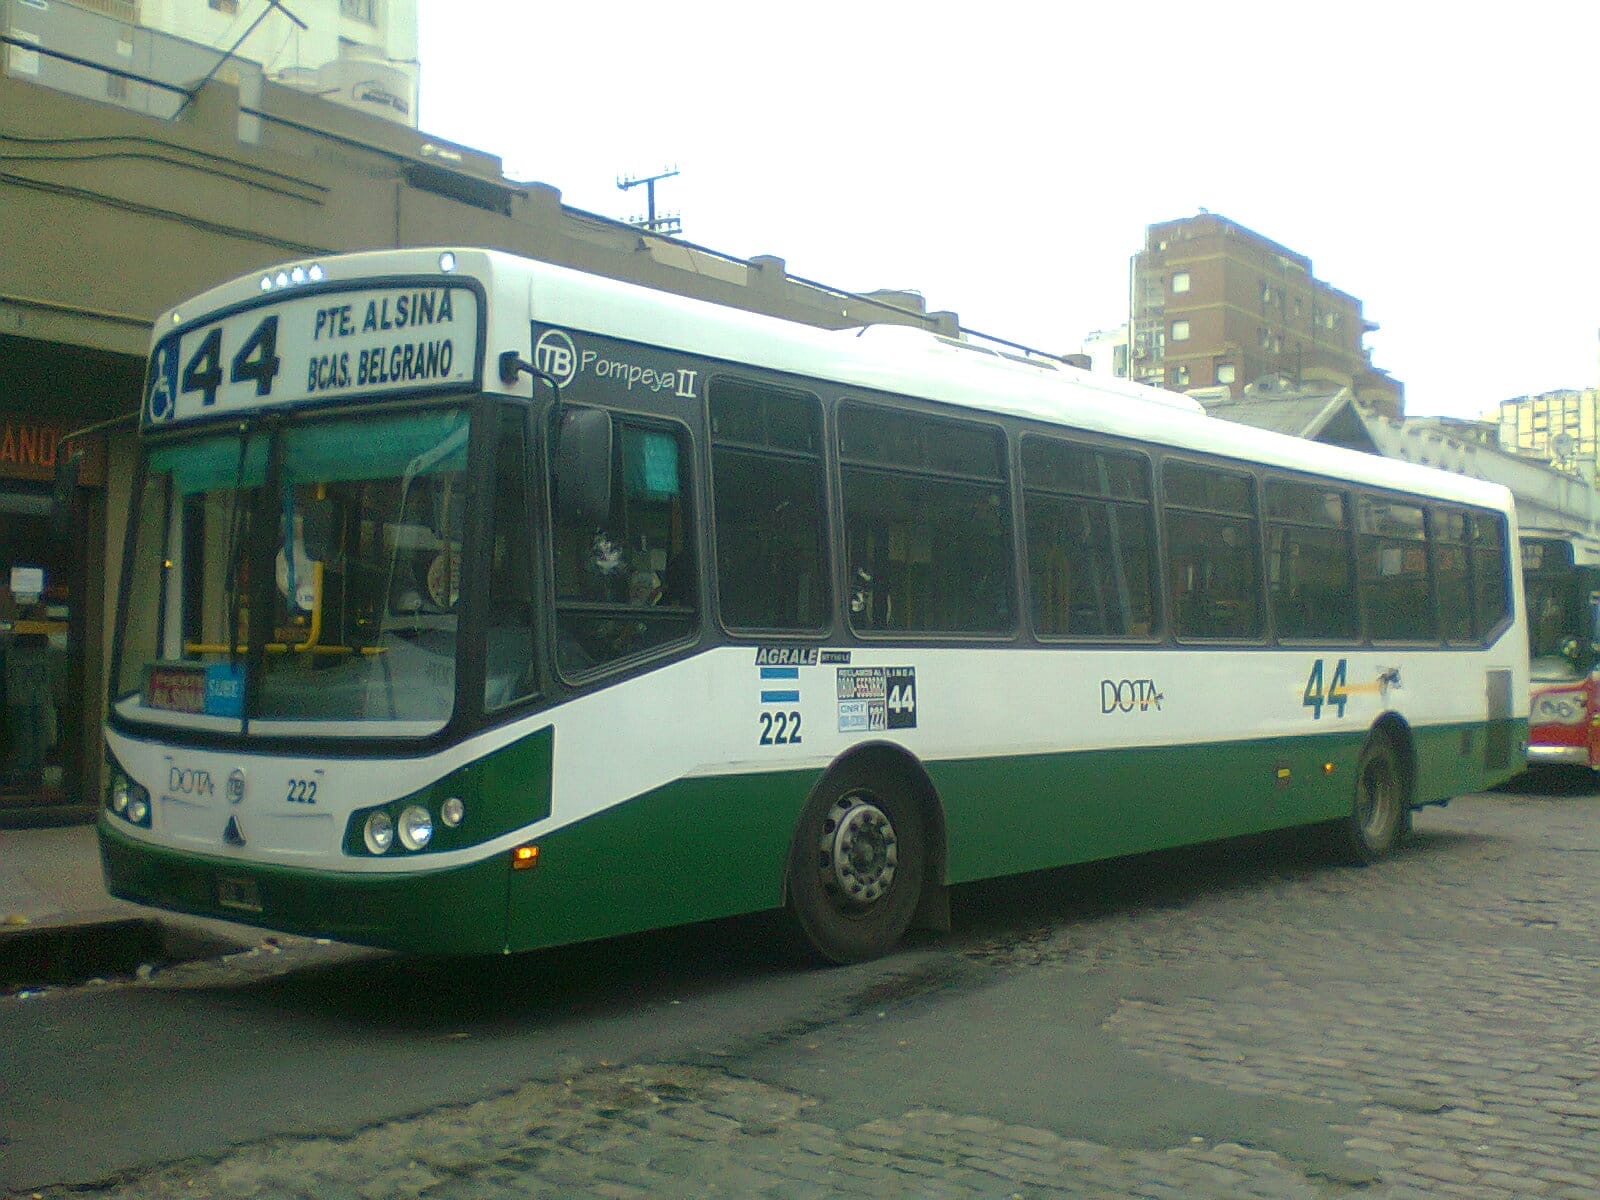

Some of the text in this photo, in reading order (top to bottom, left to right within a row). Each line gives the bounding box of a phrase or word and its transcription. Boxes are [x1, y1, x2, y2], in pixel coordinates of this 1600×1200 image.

[314, 288, 453, 341] PTE. ALSINA
[181, 314, 281, 406] 44
[307, 339, 454, 393] BCAS. BELGRANO
[580, 350, 675, 393] Pompeya
[757, 647, 818, 666] AGRALE
[888, 684, 915, 714] 44
[1101, 678, 1163, 714] DOTA
[1302, 658, 1348, 720] 44
[759, 711, 802, 745] 222
[286, 779, 318, 804] 222
